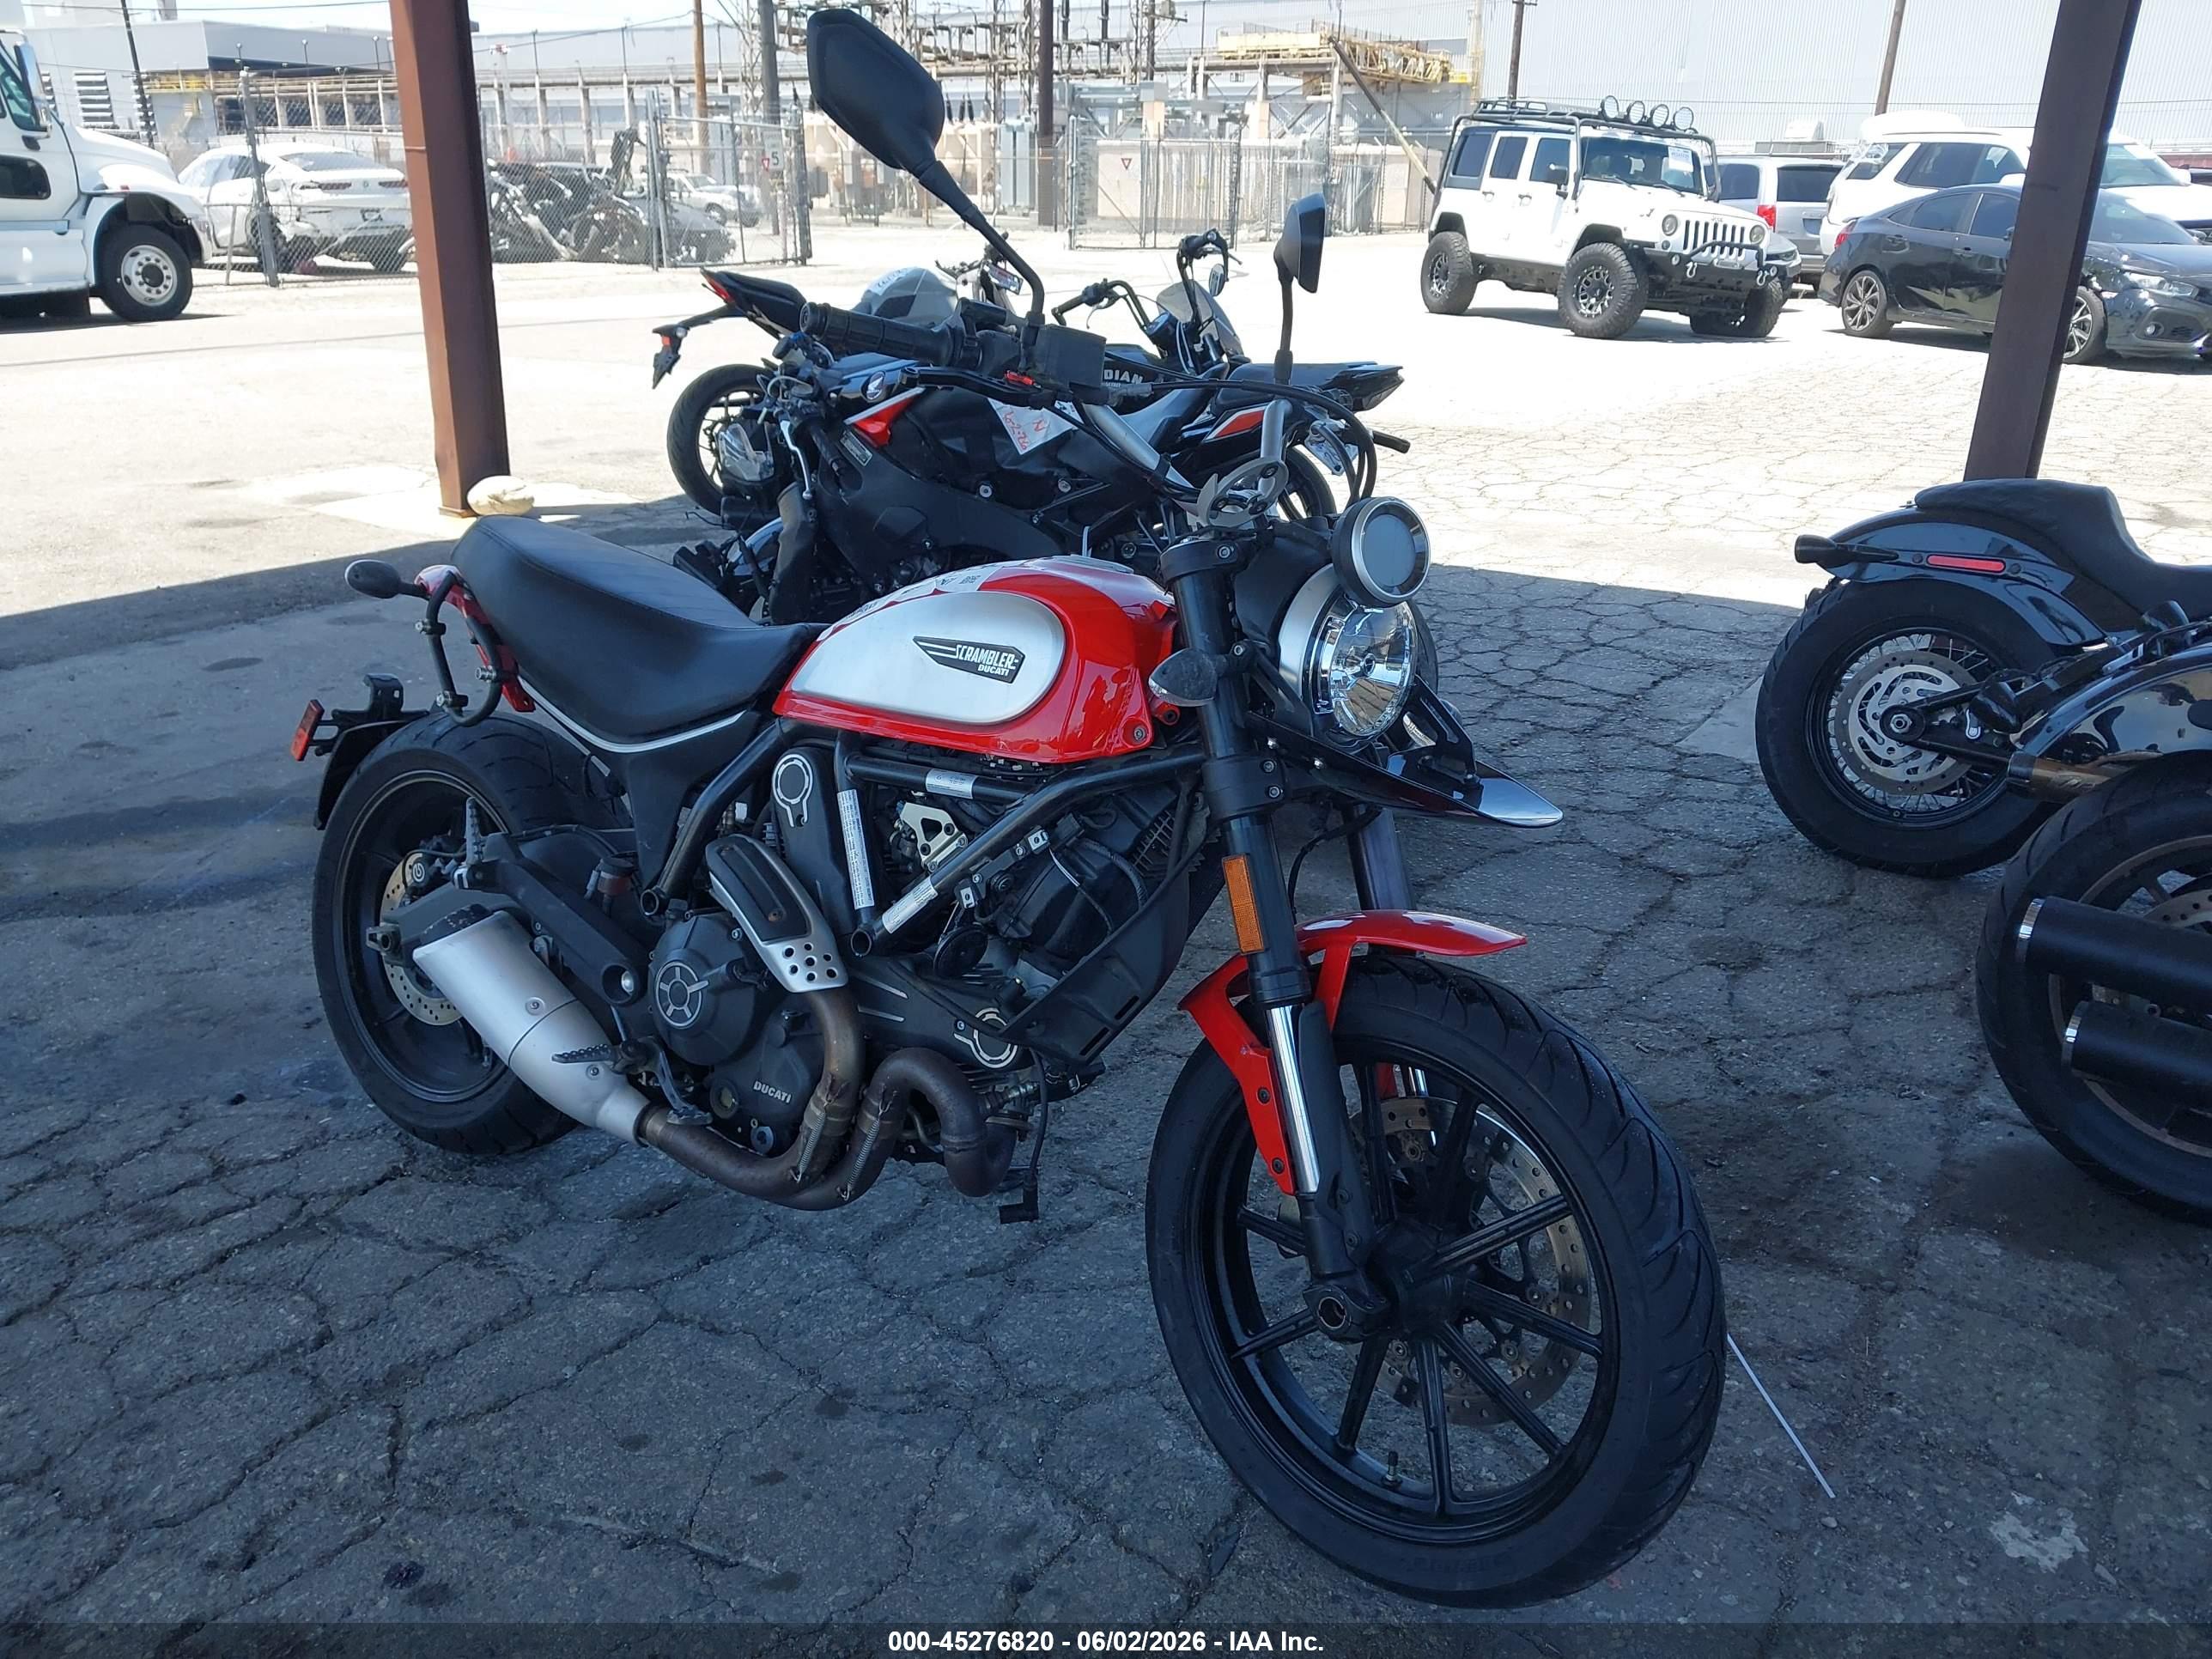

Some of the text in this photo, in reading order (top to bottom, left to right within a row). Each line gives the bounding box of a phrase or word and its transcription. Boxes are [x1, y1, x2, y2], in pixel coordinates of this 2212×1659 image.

[771, 151, 779, 165] 5
[956, 644, 1019, 670] SCRAMBLER
[977, 664, 1010, 677] DUCATI
[753, 1080, 792, 1103] DUCATI
